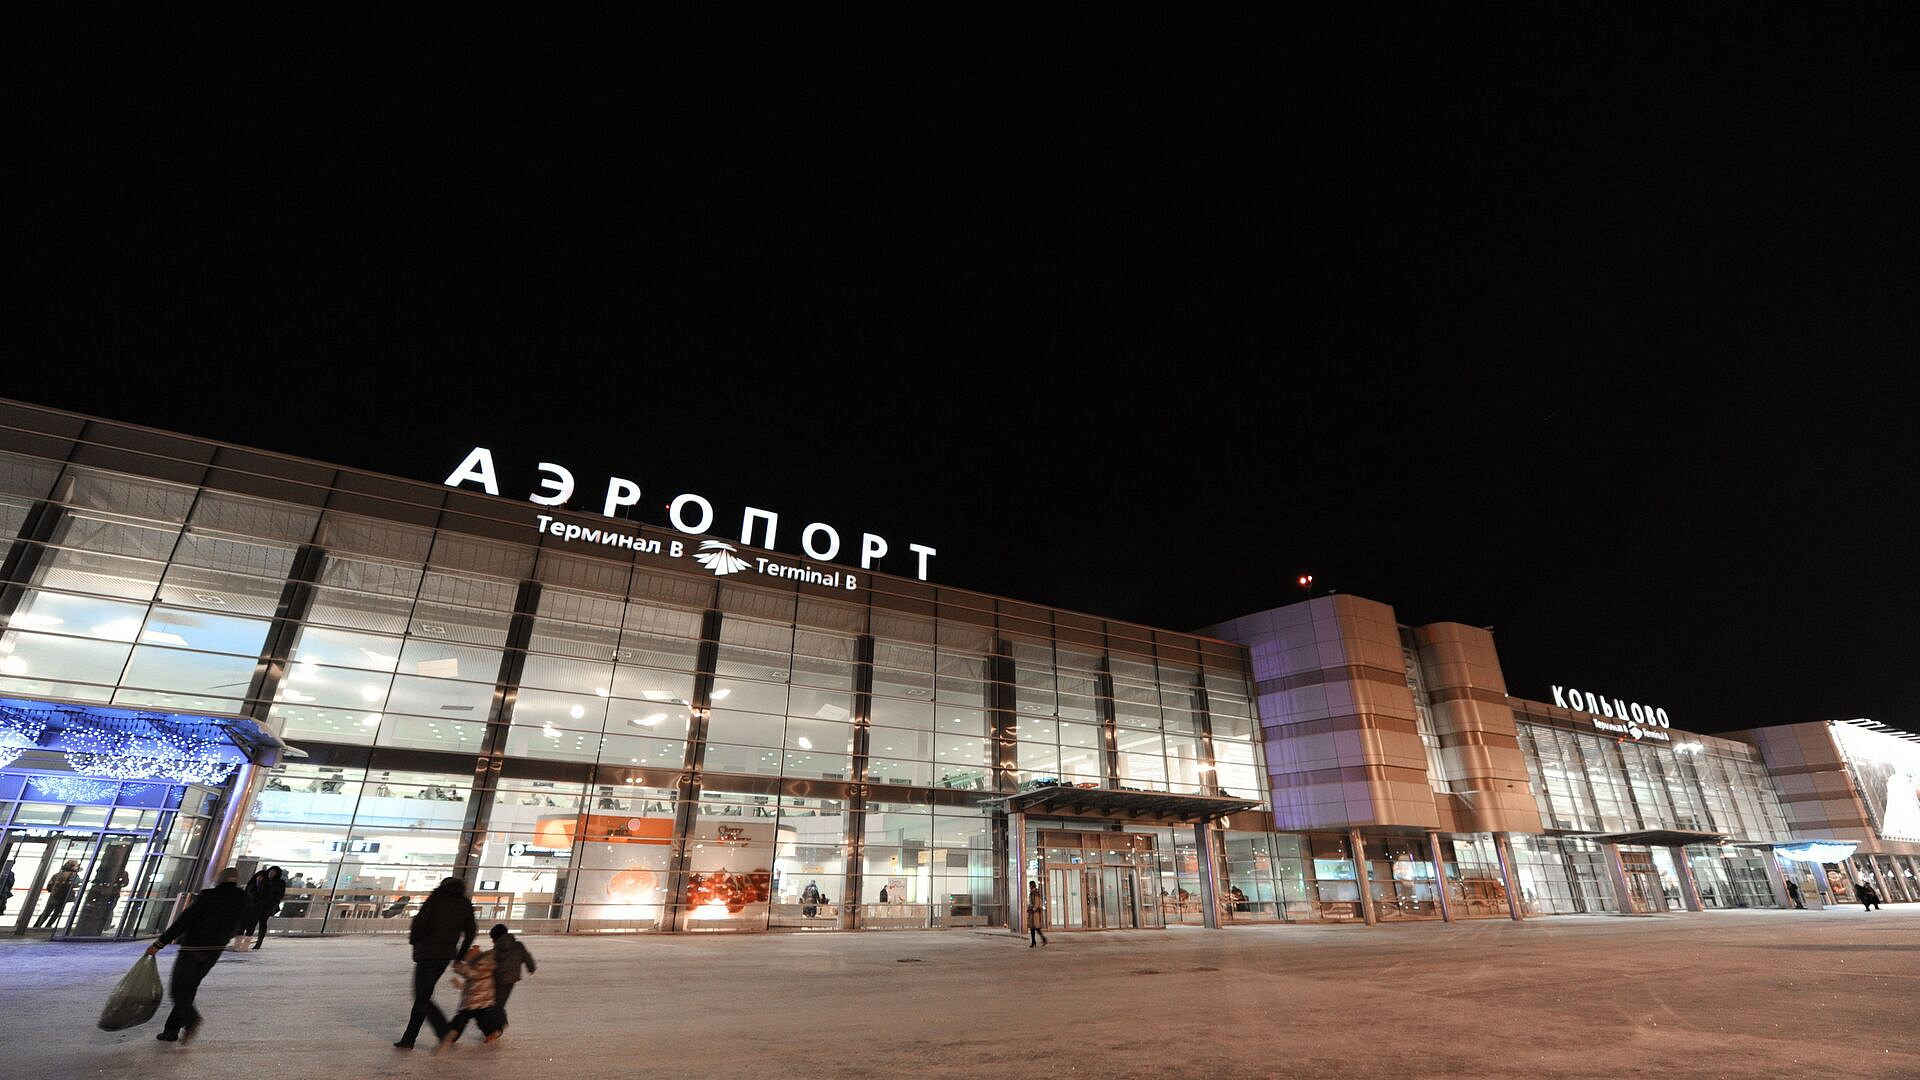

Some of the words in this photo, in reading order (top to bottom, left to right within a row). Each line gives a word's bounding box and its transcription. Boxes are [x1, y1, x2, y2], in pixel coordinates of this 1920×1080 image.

[444, 446, 937, 582] АЭРОПОРТ
[536, 514, 661, 554] Терминал
[755, 557, 840, 588] Terminal
[844, 574, 857, 591] B
[1551, 684, 1670, 729] КОЛЬЦОВО
